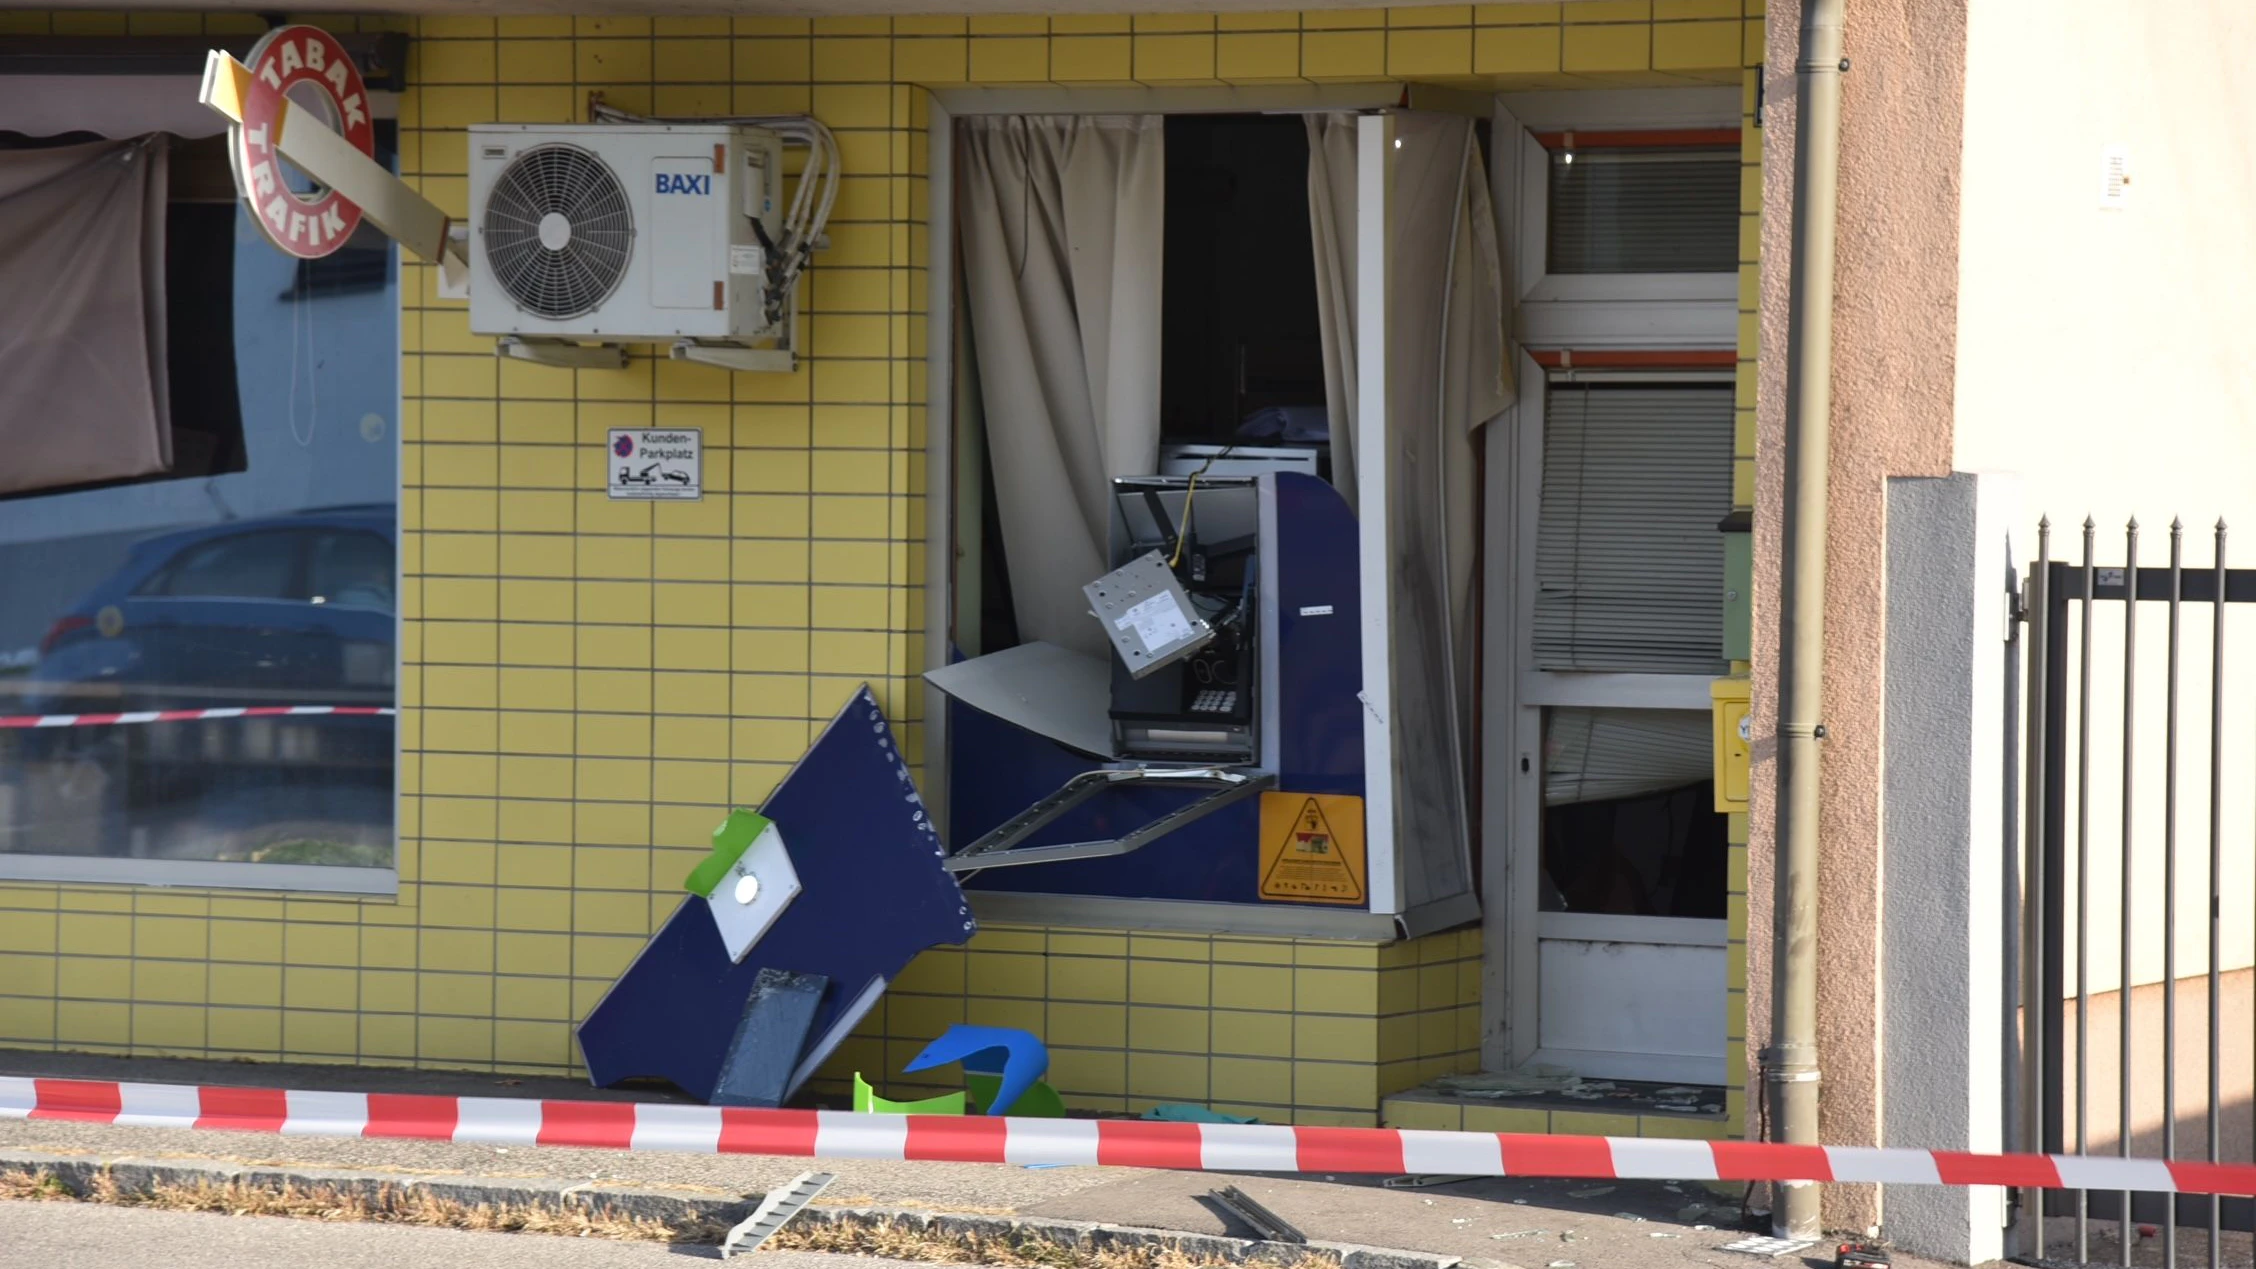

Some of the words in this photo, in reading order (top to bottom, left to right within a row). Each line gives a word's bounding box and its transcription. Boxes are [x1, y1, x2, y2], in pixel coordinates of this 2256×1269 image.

[260, 38, 366, 131] TABAK
[248, 122, 346, 246] TRAFIK
[656, 173, 710, 195] BAXI
[642, 432, 692, 444] Kunden-
[640, 448, 694, 461] Parkplatz
